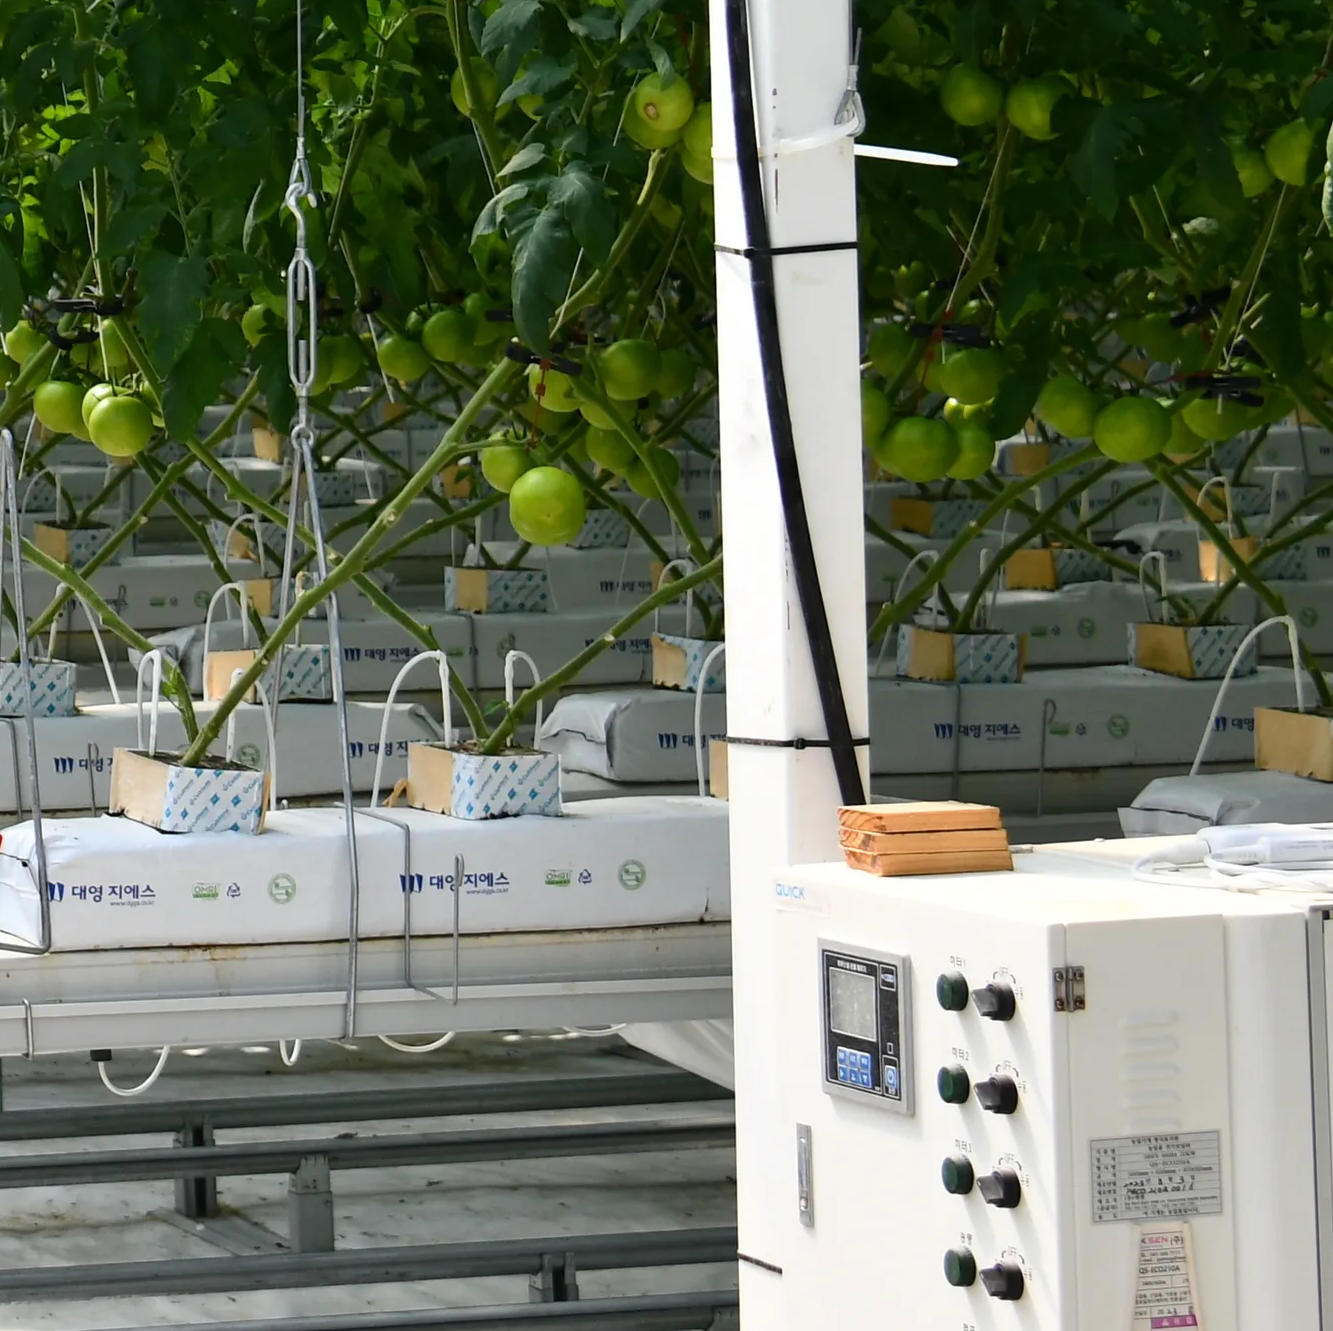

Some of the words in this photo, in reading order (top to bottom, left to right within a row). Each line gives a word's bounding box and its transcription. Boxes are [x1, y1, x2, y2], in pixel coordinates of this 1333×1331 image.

[958, 724, 981, 738] 대영
[985, 723, 1021, 736] 지에스
[463, 872, 510, 888] 지에스
[71, 884, 103, 903] 대영
[108, 883, 156, 900] 지에스
[775, 882, 806, 900] QUICK
